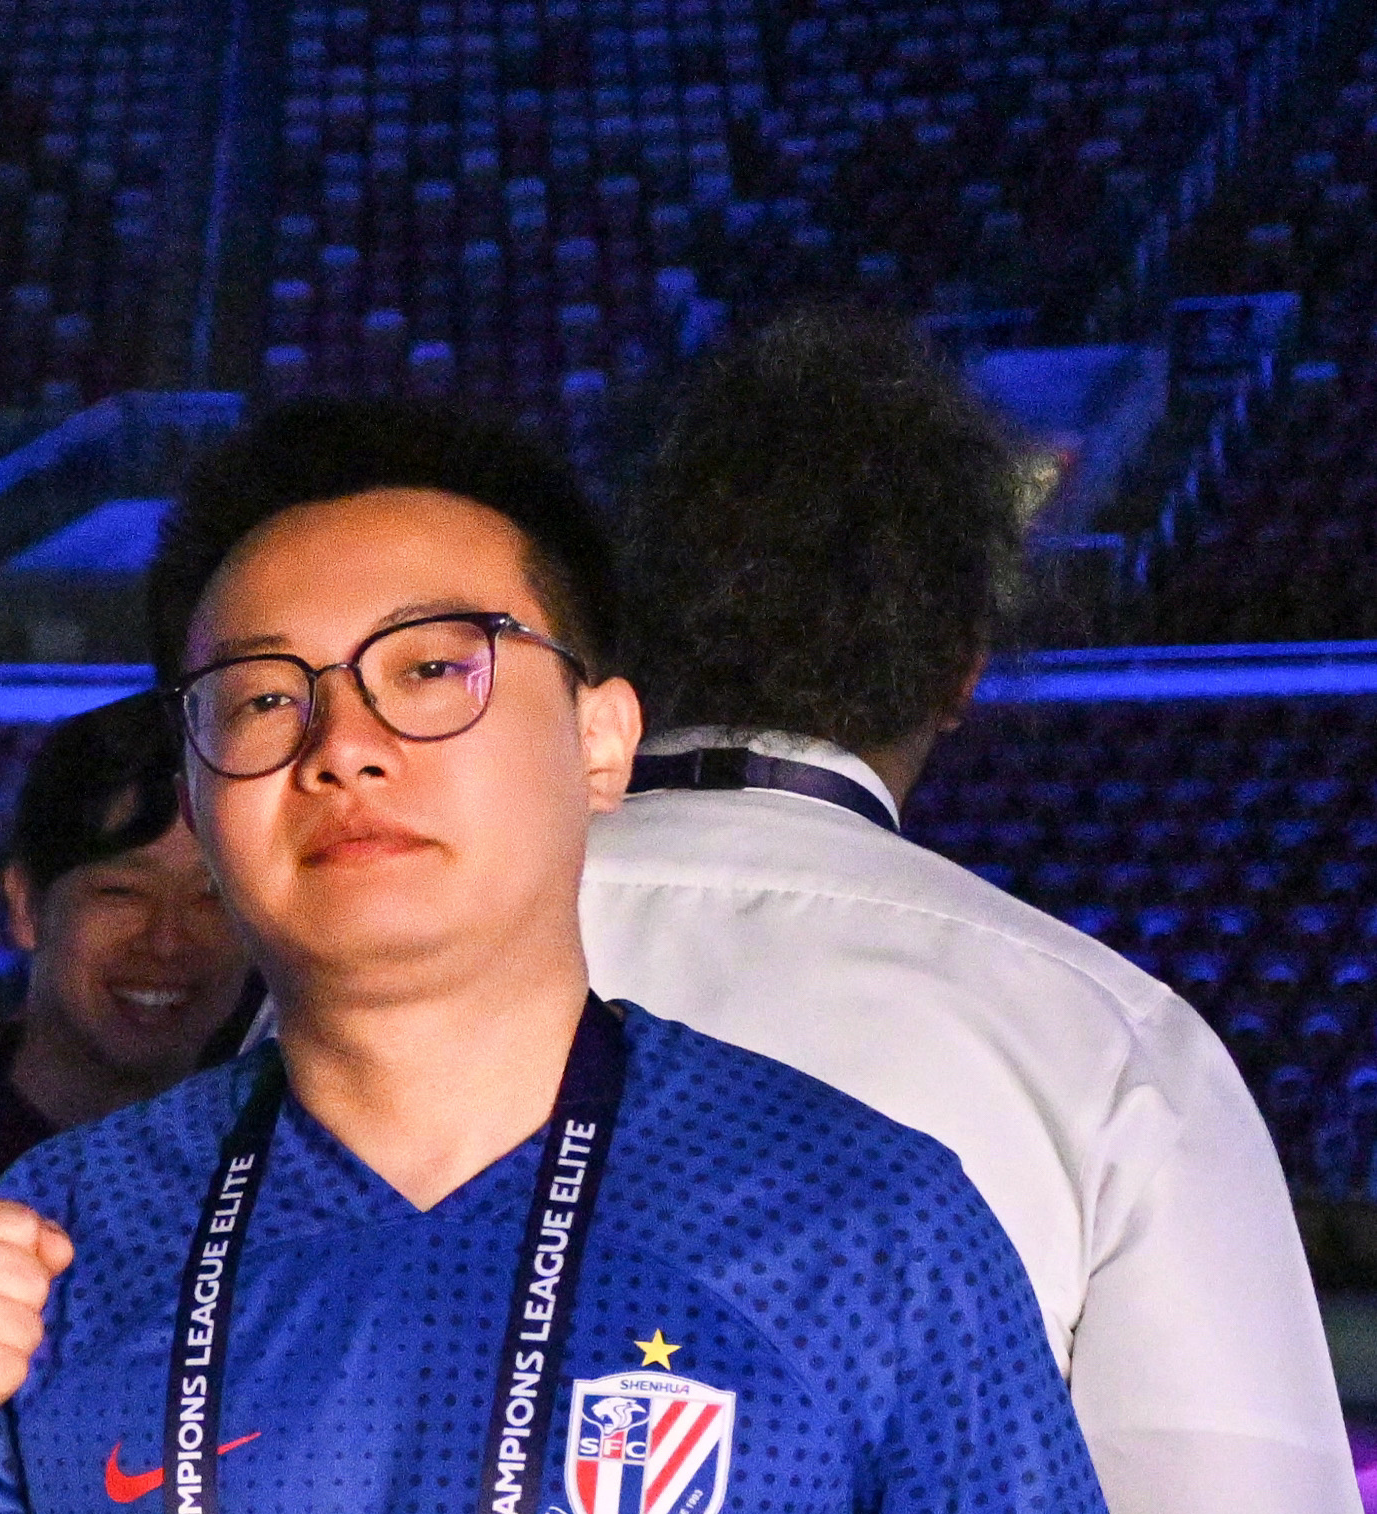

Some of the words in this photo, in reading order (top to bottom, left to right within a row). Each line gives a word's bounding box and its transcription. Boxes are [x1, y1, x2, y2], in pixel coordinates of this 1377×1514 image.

[185, 1239, 229, 1366] LEAGUE
[209, 1153, 256, 1234] ELITE
[519, 1209, 575, 1342] LEAGUE
[549, 1119, 597, 1204] ELITE
[619, 1378, 690, 1396] SHENHUA
[579, 1436, 648, 1459] SFC
